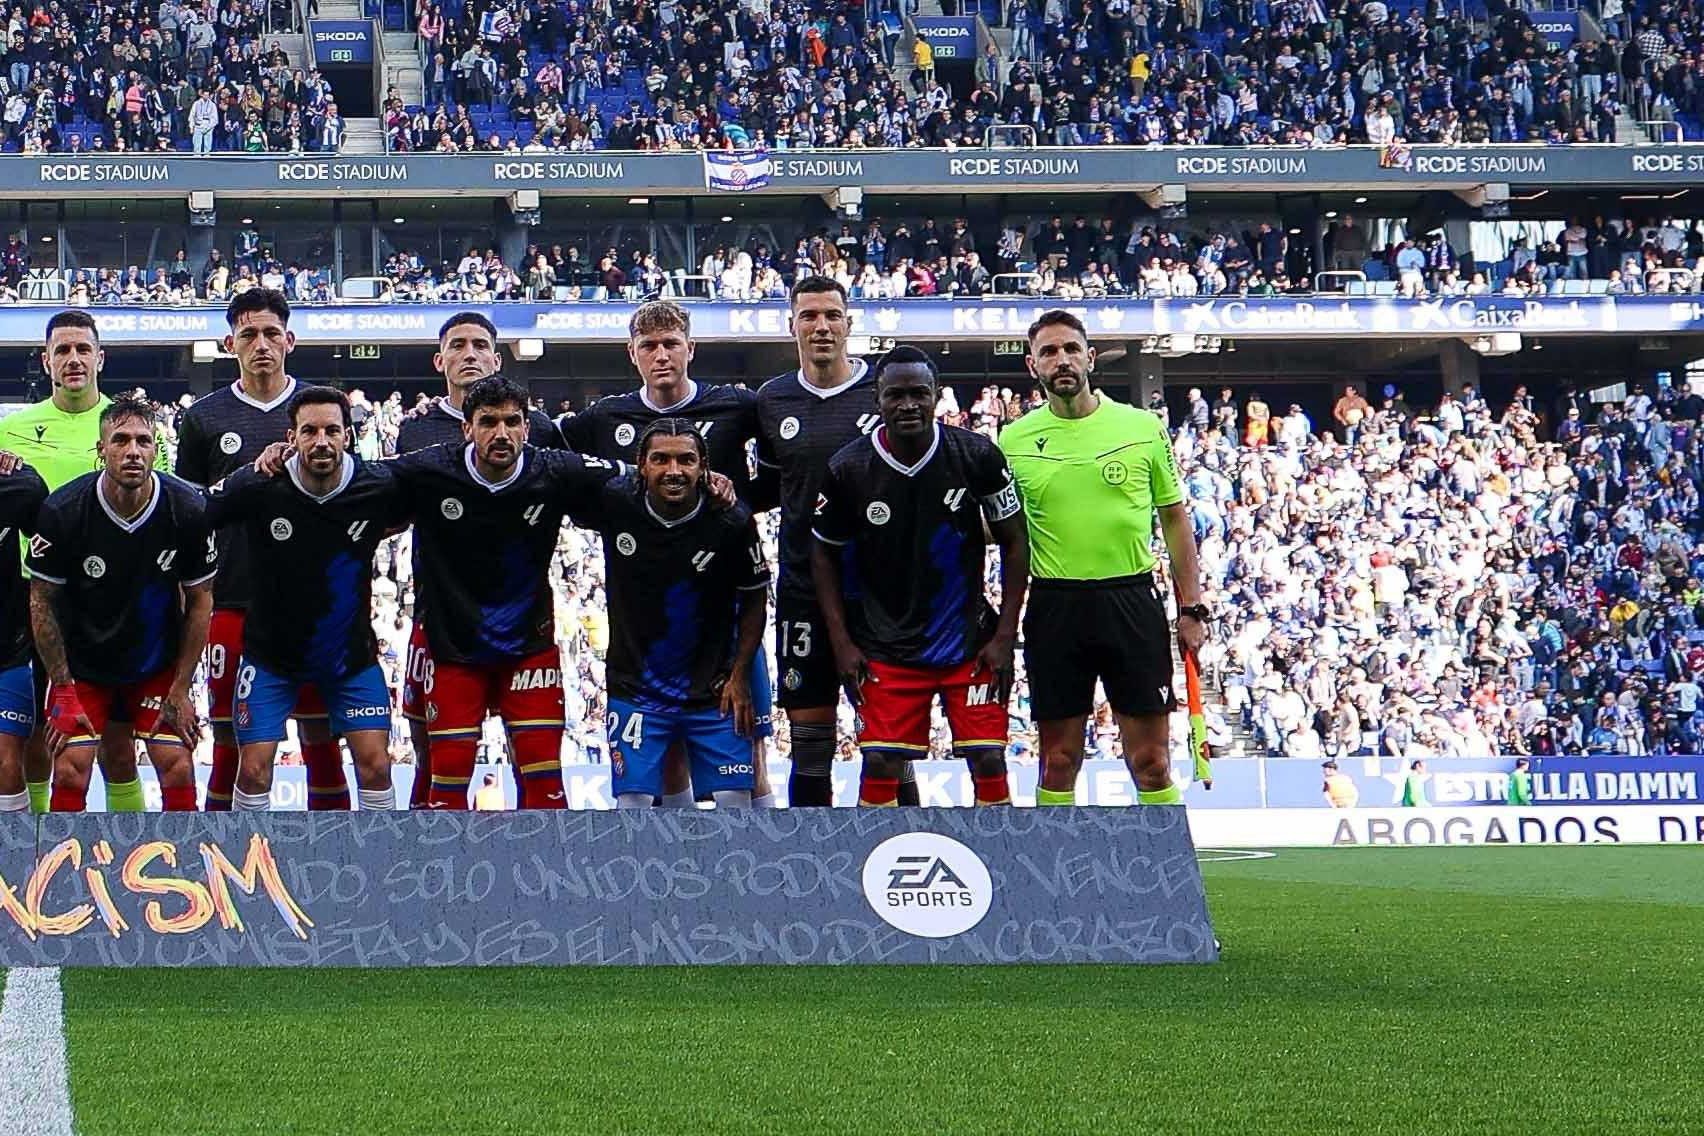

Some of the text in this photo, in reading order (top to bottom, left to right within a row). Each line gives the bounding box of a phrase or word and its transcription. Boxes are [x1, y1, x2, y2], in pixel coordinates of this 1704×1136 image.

[315, 31, 367, 41] SKODA
[919, 27, 970, 37] SKODA
[278, 162, 407, 180] RCDE STADIUM
[494, 161, 623, 179] RCDE STADIUM
[788, 160, 864, 177] STADIUM
[950, 158, 1081, 176] RCDE STADIUM
[1176, 157, 1307, 175] RCDE STADIUM
[1415, 155, 1546, 173] RCDE STADIUM
[1632, 154, 1684, 171] RCDE
[40, 163, 169, 181] RCDE STADIUM
[139, 316, 208, 331] STADIUM
[357, 314, 426, 330] STADIUM
[1448, 301, 1589, 329] CaixaBank
[995, 484, 1016, 507] VS
[871, 506, 887, 515] EA
[781, 621, 812, 657] 13
[237, 665, 256, 699] 8
[608, 711, 644, 750] 24
[1595, 770, 1698, 802] DAMM
[1332, 815, 1620, 844] ABOGADOS
[887, 855, 969, 890] EA
[887, 890, 973, 908] SPORTS
